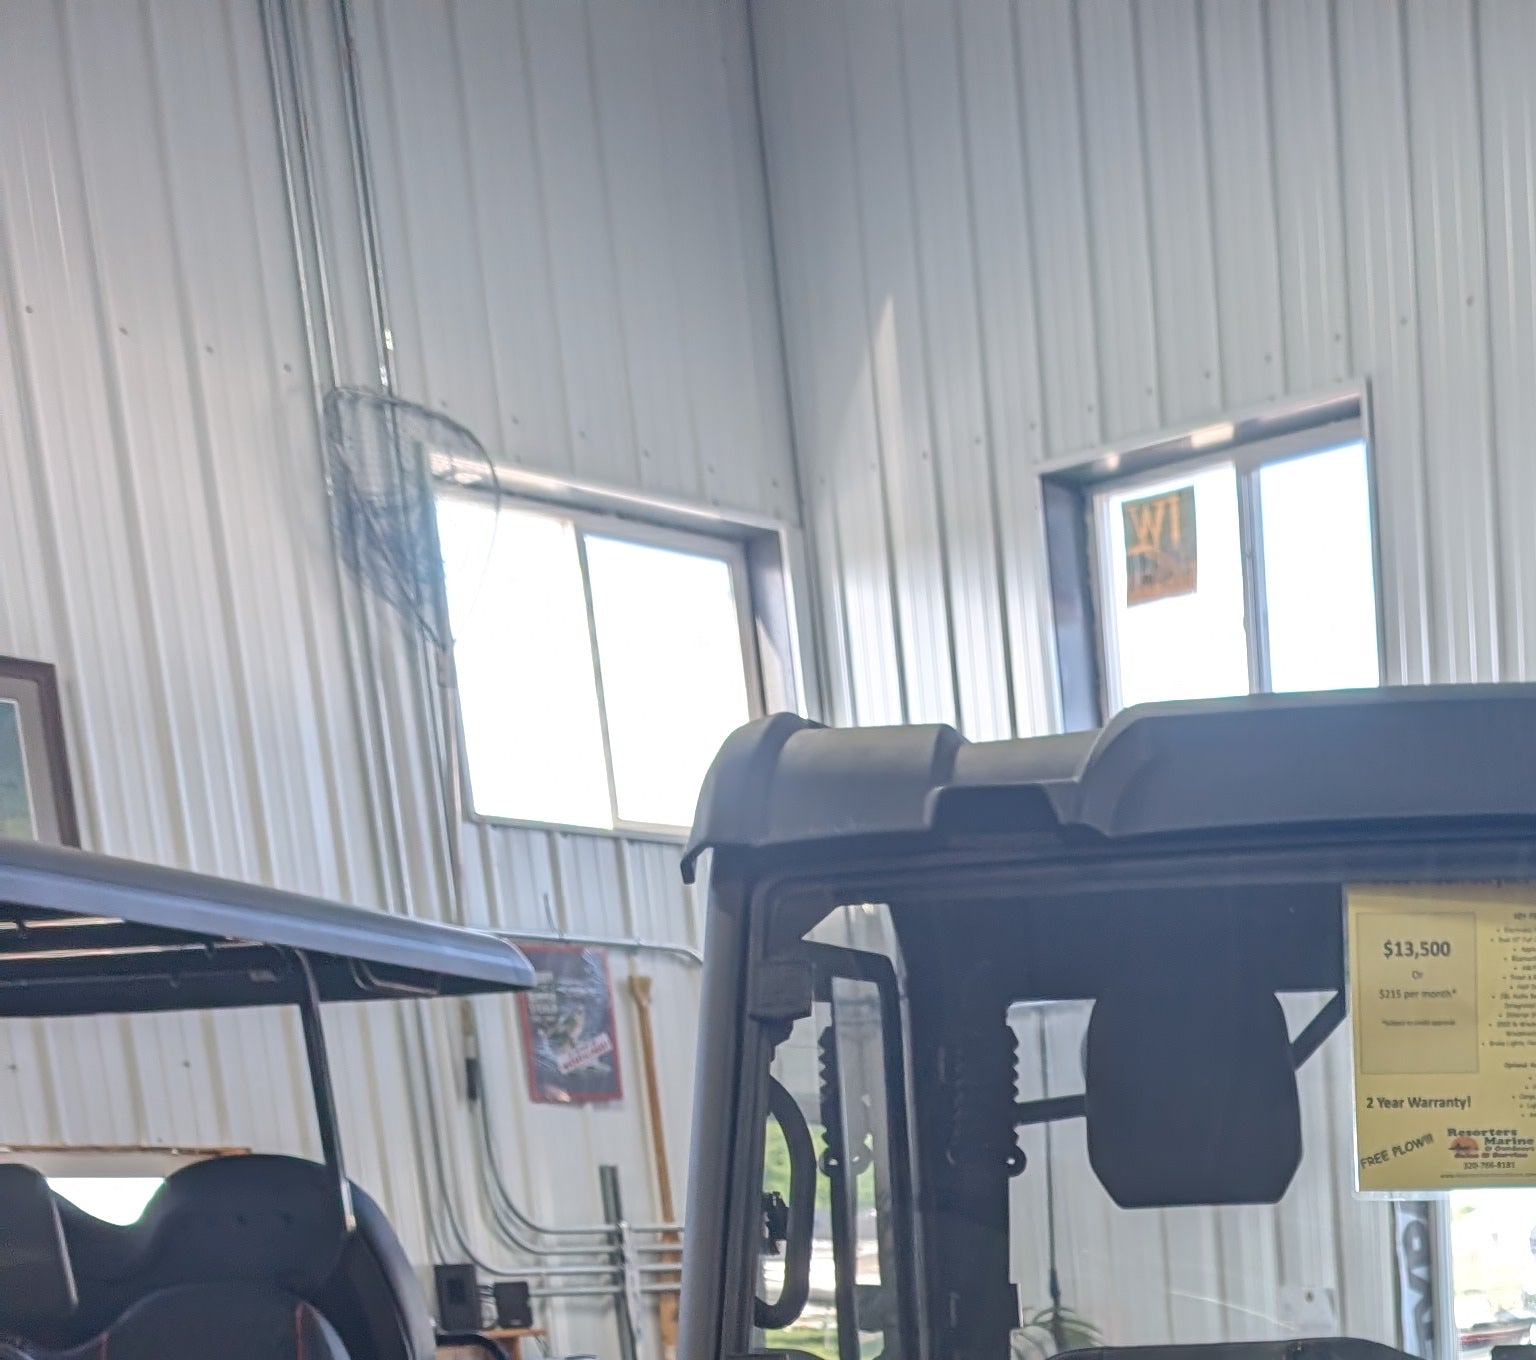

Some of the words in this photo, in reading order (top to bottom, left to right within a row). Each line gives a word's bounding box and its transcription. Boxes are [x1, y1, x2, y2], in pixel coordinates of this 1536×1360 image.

[1383, 940, 1451, 959] $13,500
[1411, 970, 1423, 980] Or
[1379, 988, 1402, 1000] $215
[1404, 991, 1419, 1000] per
[1366, 1098, 1374, 1108] 2
[1377, 1098, 1404, 1108] Year
[1407, 1096, 1472, 1111] Warranty!
[1447, 1128, 1518, 1137] Resorters
[1484, 1137, 1535, 1146] Marine
[1360, 1149, 1389, 1169] FREE
